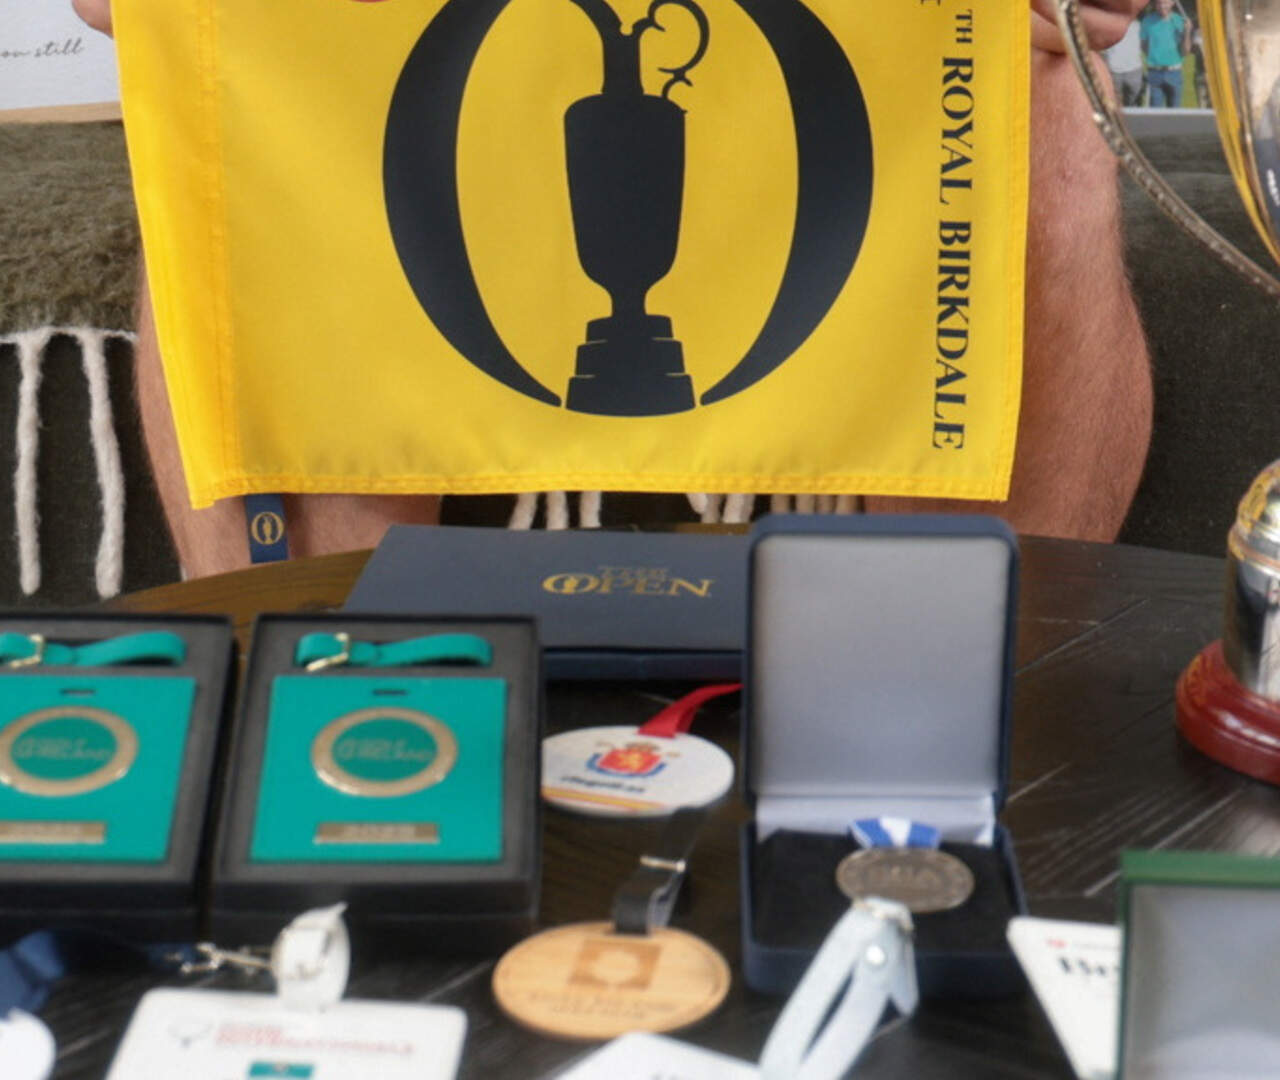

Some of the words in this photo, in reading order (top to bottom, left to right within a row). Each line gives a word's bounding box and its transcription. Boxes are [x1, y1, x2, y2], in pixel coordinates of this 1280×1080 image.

[34, 37, 84, 58] still
[939, 57, 975, 205] ROYAL
[932, 220, 972, 450] BIRKDALE
